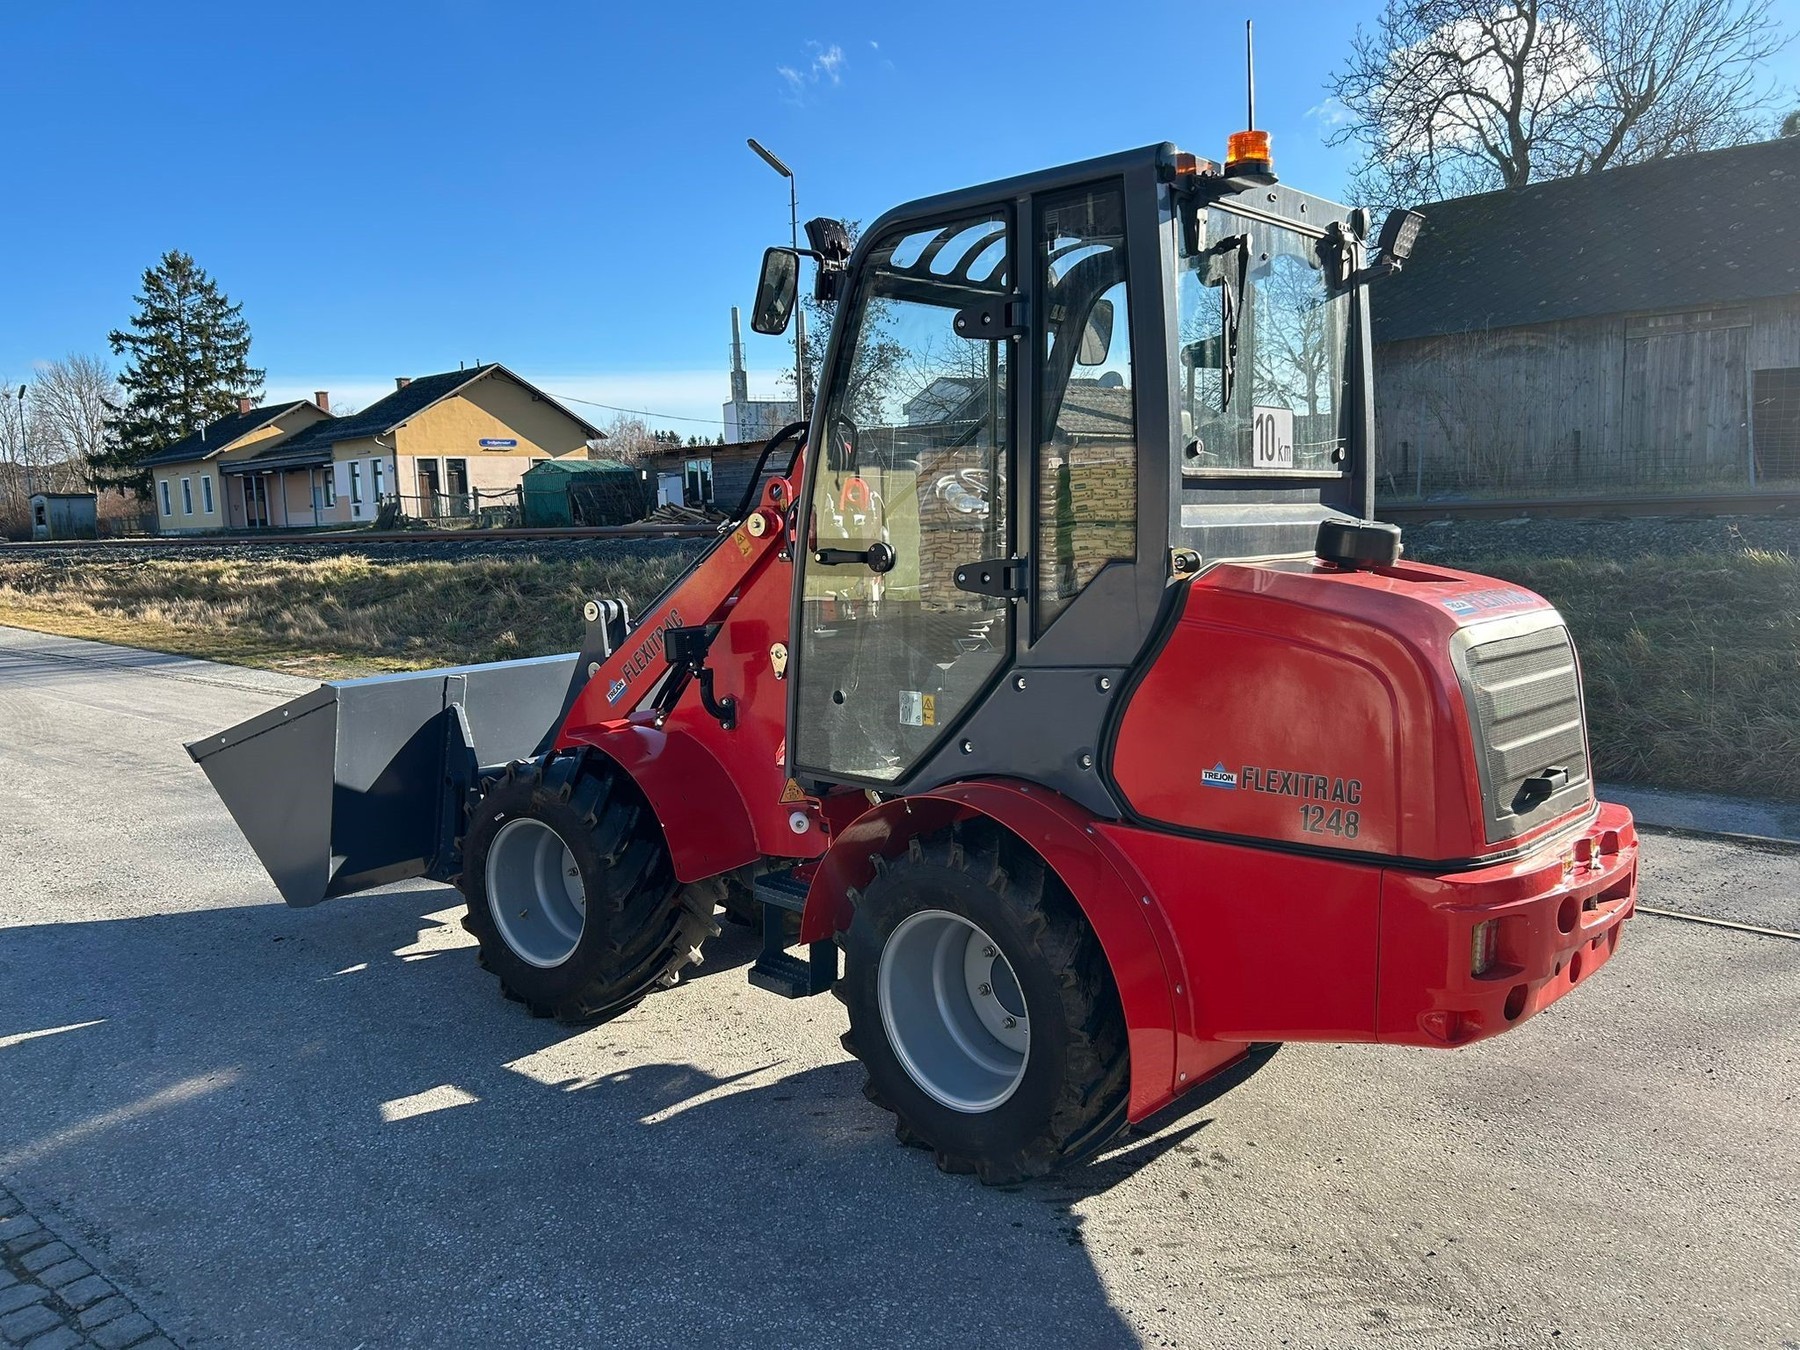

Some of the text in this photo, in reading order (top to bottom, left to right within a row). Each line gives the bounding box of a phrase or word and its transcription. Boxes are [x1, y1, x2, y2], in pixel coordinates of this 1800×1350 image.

[1256, 413, 1291, 461] 10 km
[1204, 766, 1361, 804] TREJON FLEXITRAC
[1300, 804, 1359, 838] 1248
